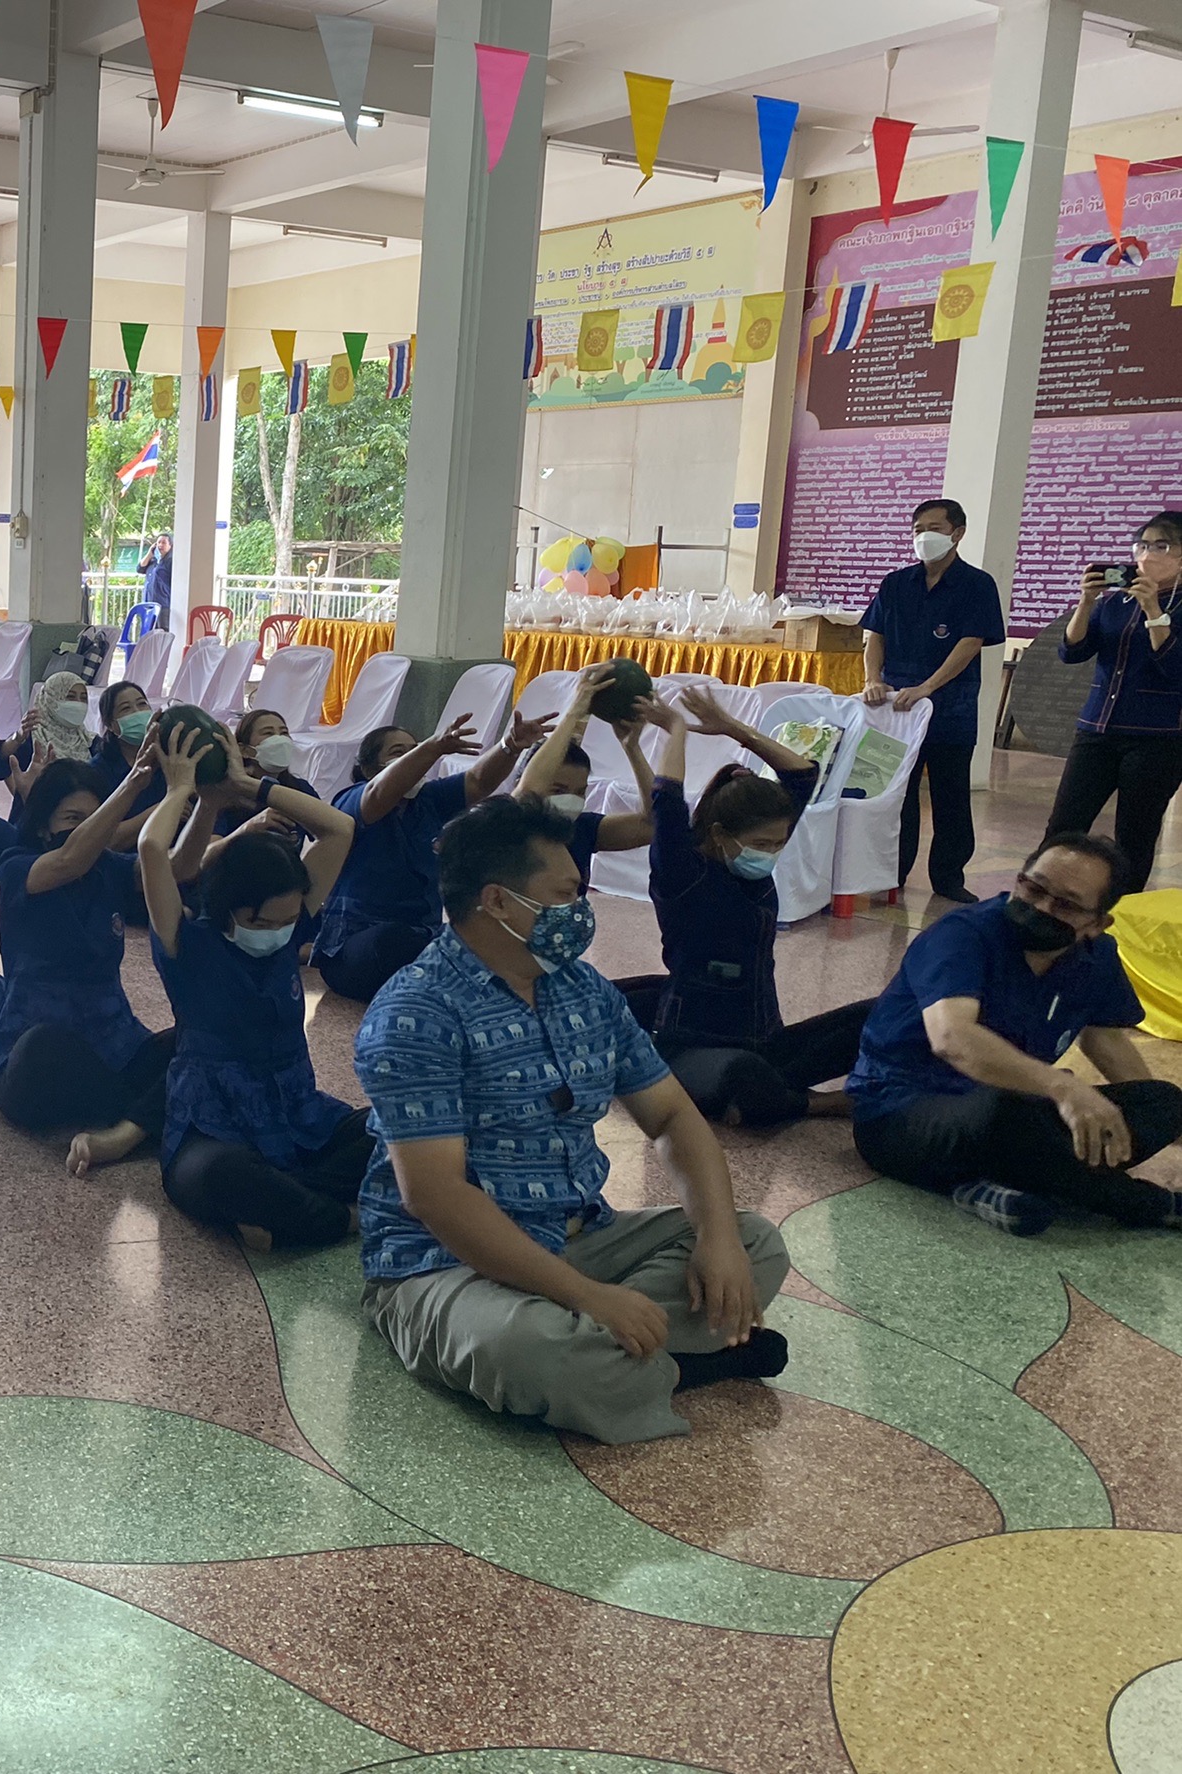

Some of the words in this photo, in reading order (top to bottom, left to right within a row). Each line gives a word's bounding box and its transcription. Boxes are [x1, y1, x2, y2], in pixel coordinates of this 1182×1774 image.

[839, 223, 943, 249] คณะเจ้าภาพกฐินเอก
